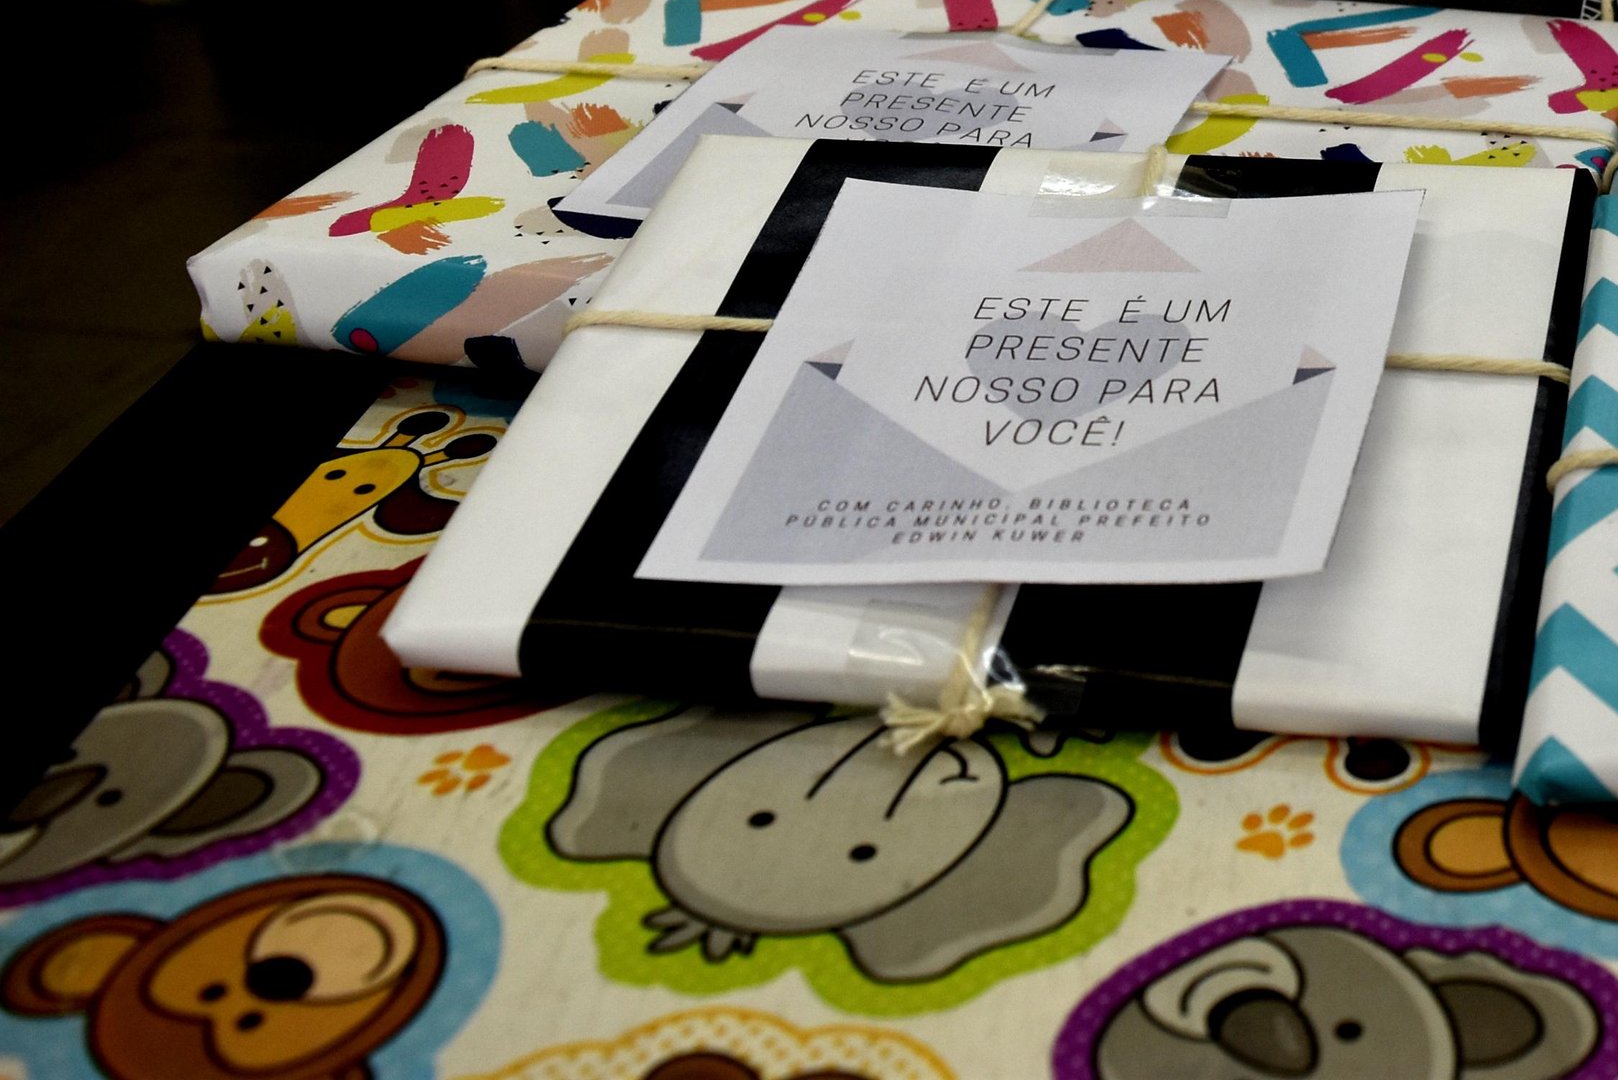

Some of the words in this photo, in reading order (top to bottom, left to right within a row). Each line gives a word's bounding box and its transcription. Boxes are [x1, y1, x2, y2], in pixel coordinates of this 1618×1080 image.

[852, 70, 945, 88] ESTE
[964, 77, 988, 94] É
[1000, 81, 1056, 98] UM
[840, 92, 1032, 123] PRESENTE
[794, 113, 924, 133] NOSSO
[936, 121, 1034, 149] PARA
[974, 297, 1090, 322] ESTE
[1118, 295, 1147, 323] É
[1163, 299, 1233, 324] UM
[965, 334, 1209, 363] PRESENTE
[914, 375, 1080, 405] NOSSO
[1098, 377, 1220, 405] PARA
[984, 416, 1125, 447] VOCÊ!
[817, 499, 870, 513] COM
[1028, 497, 1190, 511] BIBLIOTECA
[913, 513, 1059, 527] MUNICIPAL
[1078, 513, 1210, 527] PREFEITO
[891, 530, 977, 544] EDWIN
[991, 529, 1085, 543] KUWER
